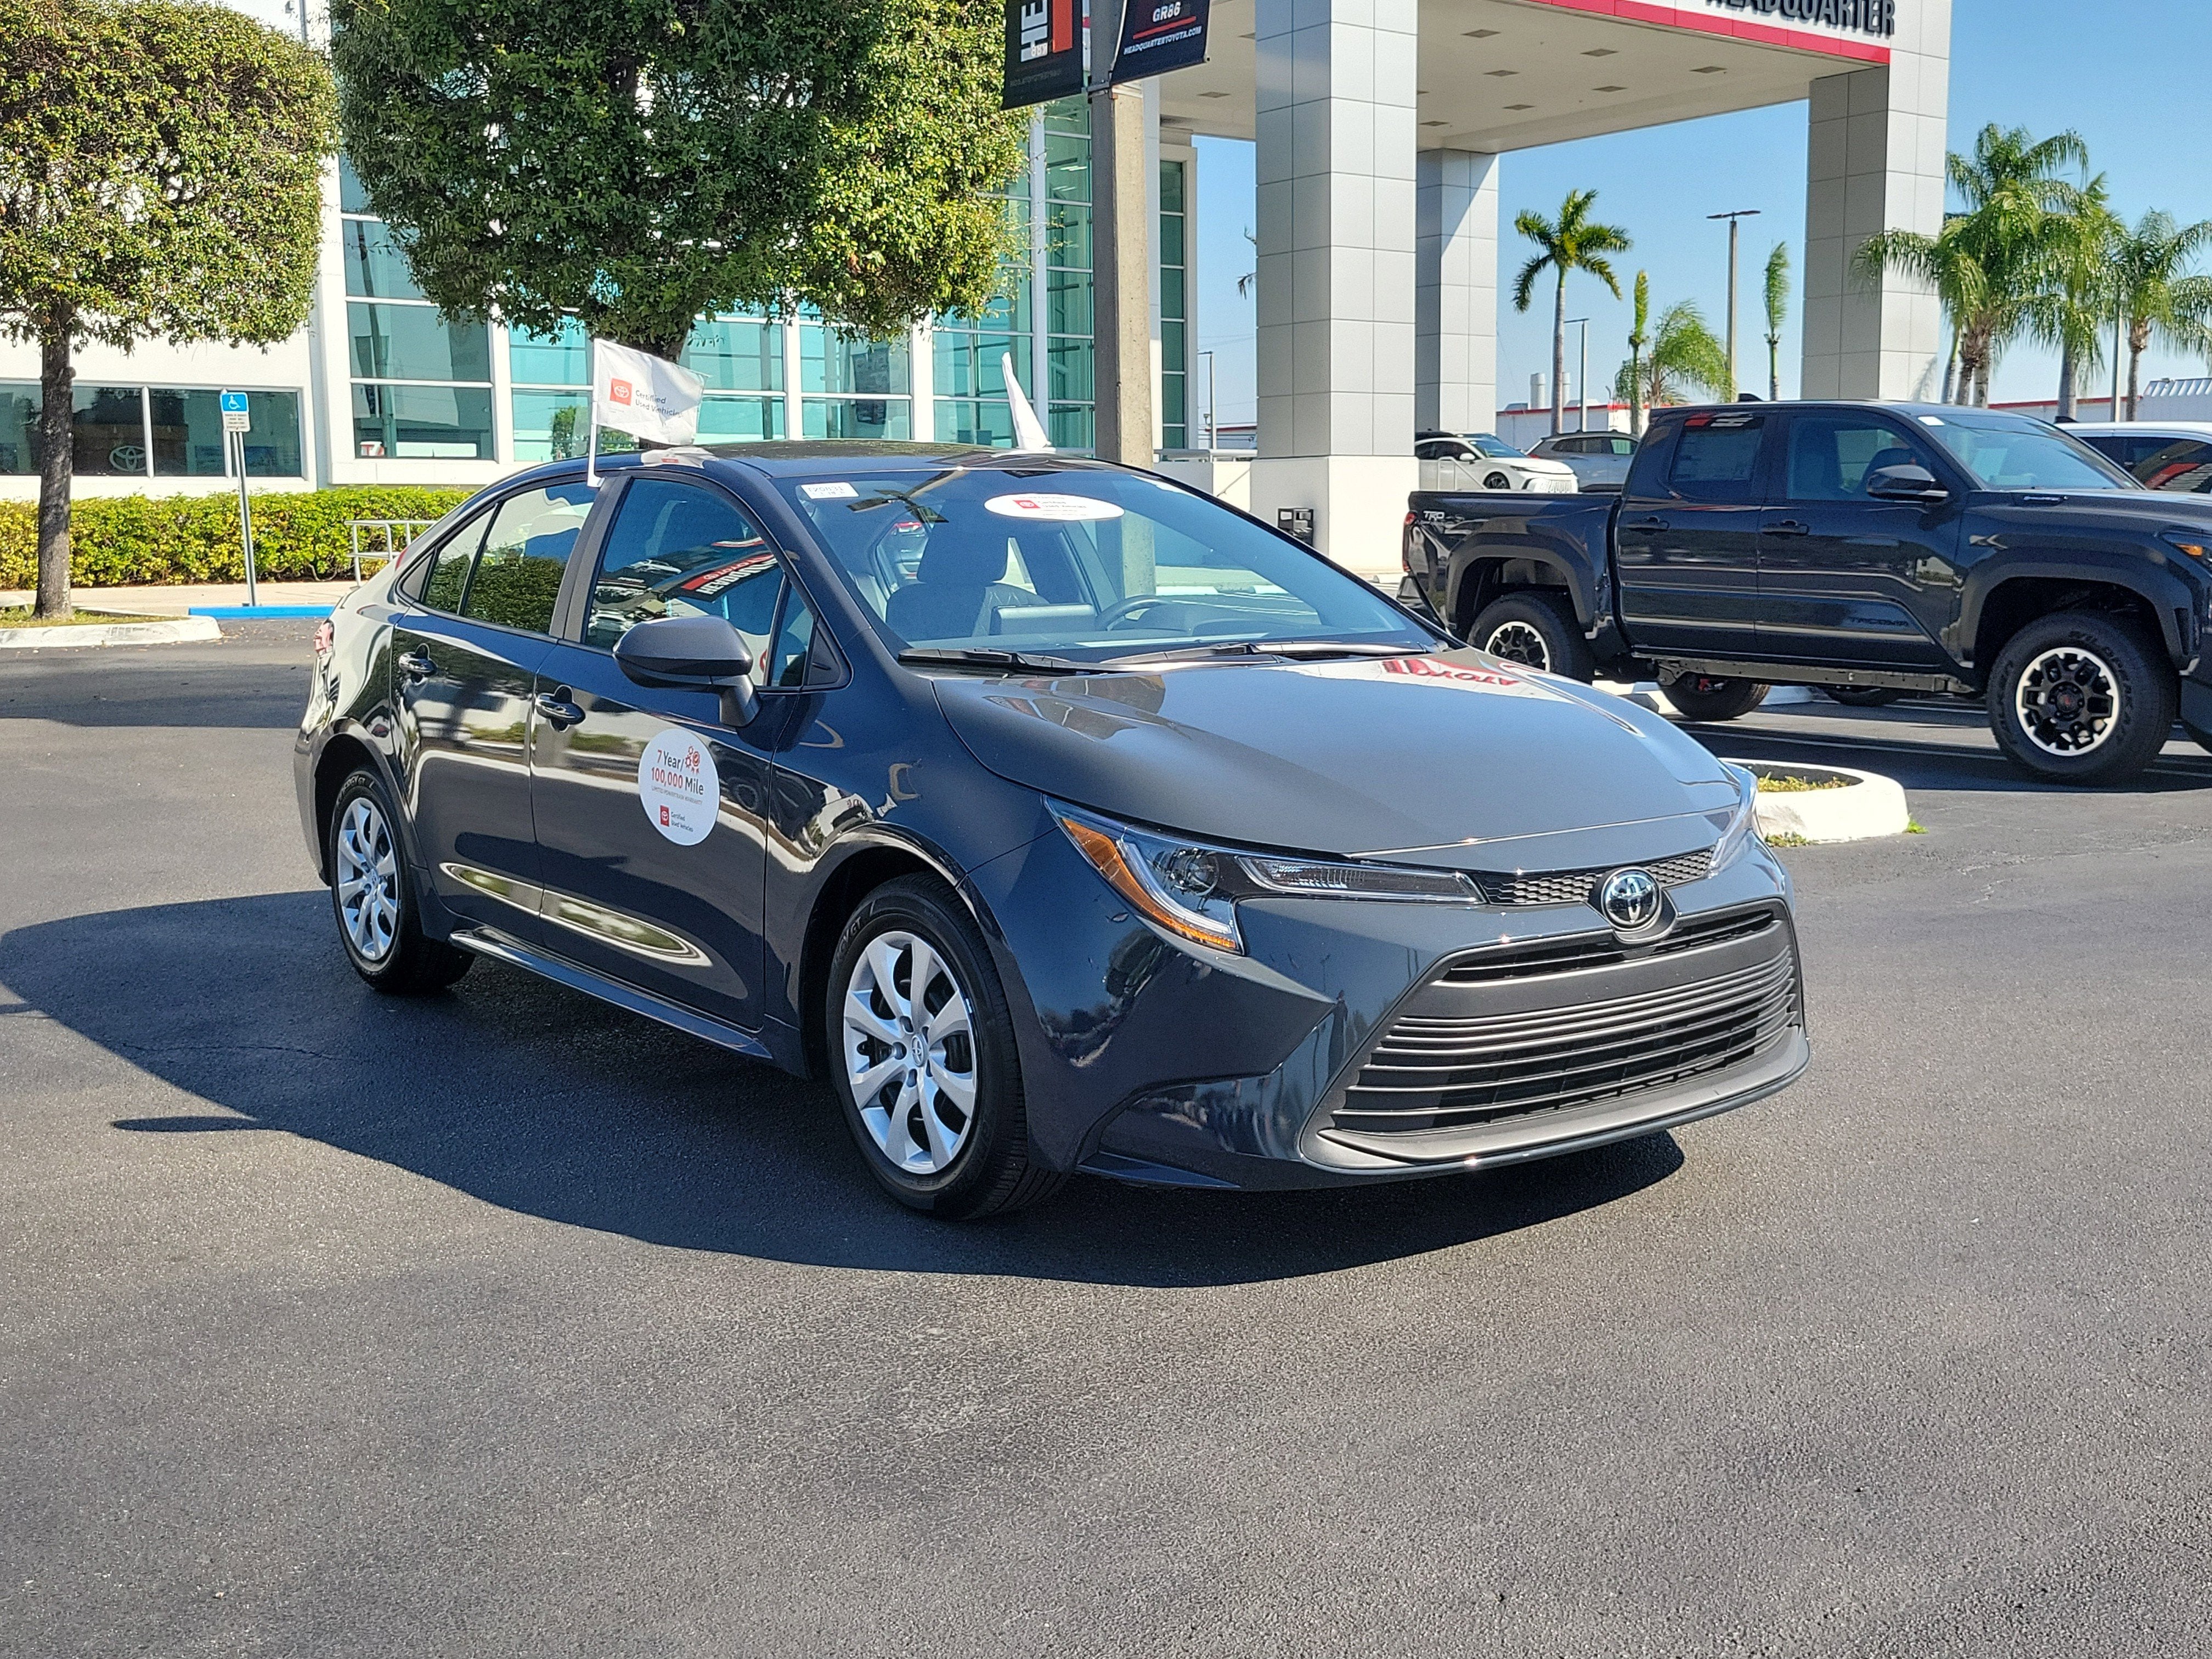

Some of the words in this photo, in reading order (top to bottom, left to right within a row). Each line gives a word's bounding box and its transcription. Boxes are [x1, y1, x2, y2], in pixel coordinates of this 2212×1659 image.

[1153, 2, 1181, 22] GR86
[1701, 0, 1894, 37] QUARTER
[1124, 26, 1202, 55] HEADQUARTERTOYOTA.COM
[636, 399, 649, 410] Used
[1423, 511, 1444, 521] TRD
[657, 749, 663, 763] 7
[663, 751, 685, 772] Year/
[652, 767, 683, 789] 100,000
[685, 777, 704, 795] Mile
[851, 916, 861, 936] GT
